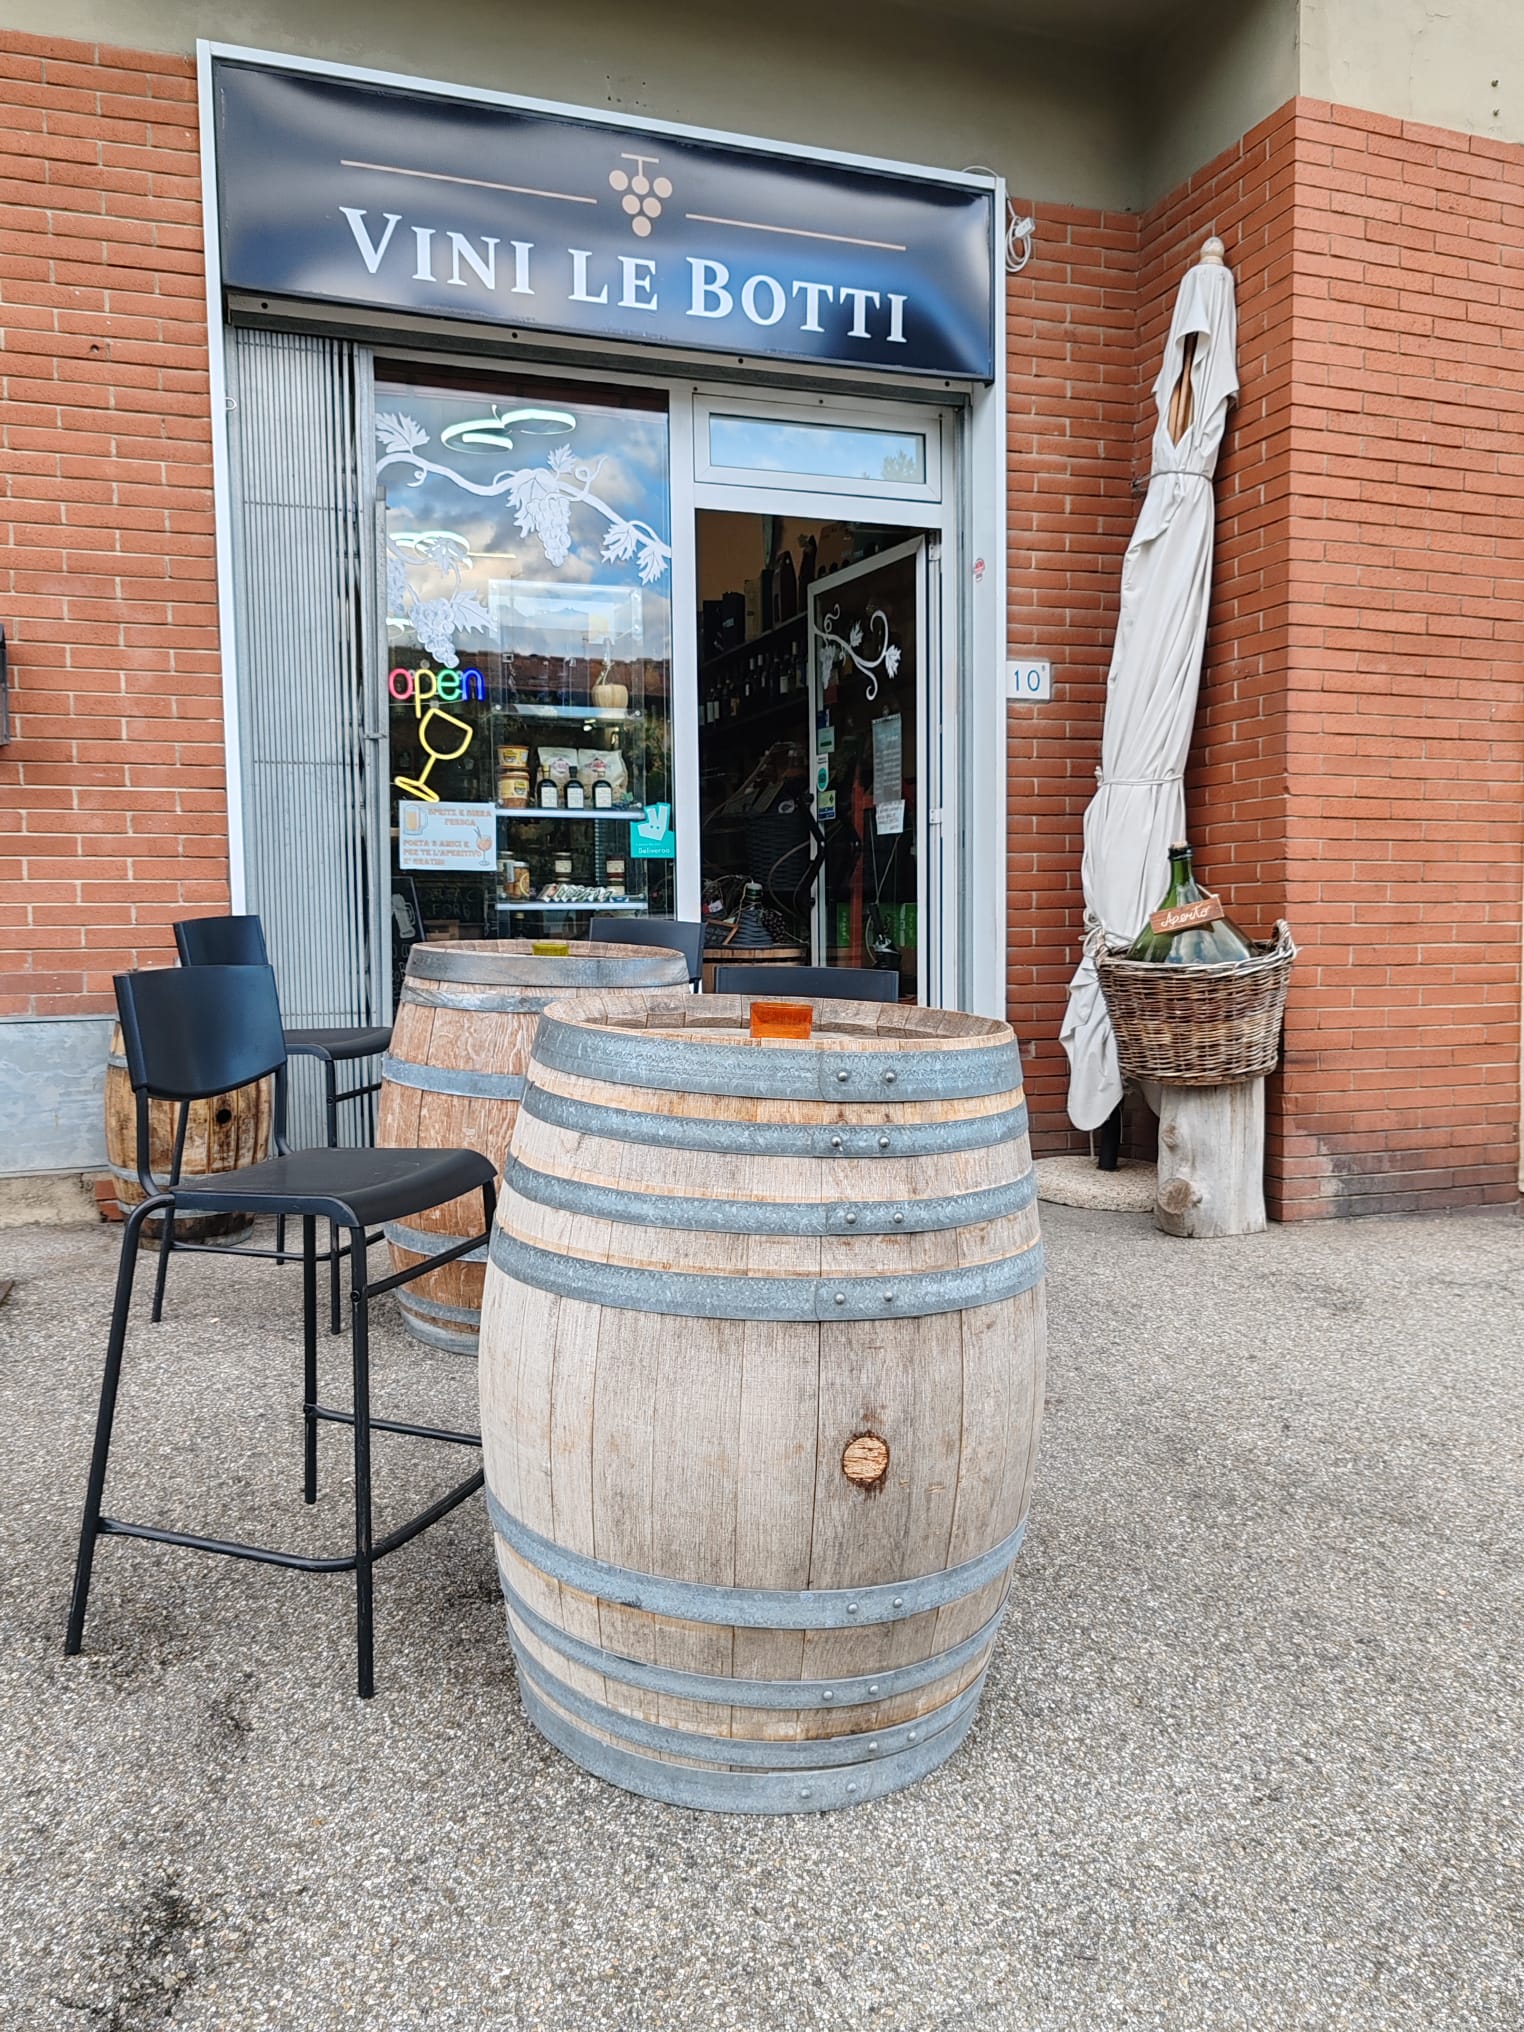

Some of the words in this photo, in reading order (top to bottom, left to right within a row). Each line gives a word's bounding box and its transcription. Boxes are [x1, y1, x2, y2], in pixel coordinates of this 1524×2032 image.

[338, 206, 536, 295] VINI
[567, 248, 659, 311] LE
[685, 256, 908, 344] BOTTI
[388, 667, 485, 719] open
[1013, 669, 1041, 692] 10
[1161, 904, 1210, 927] Aperto
